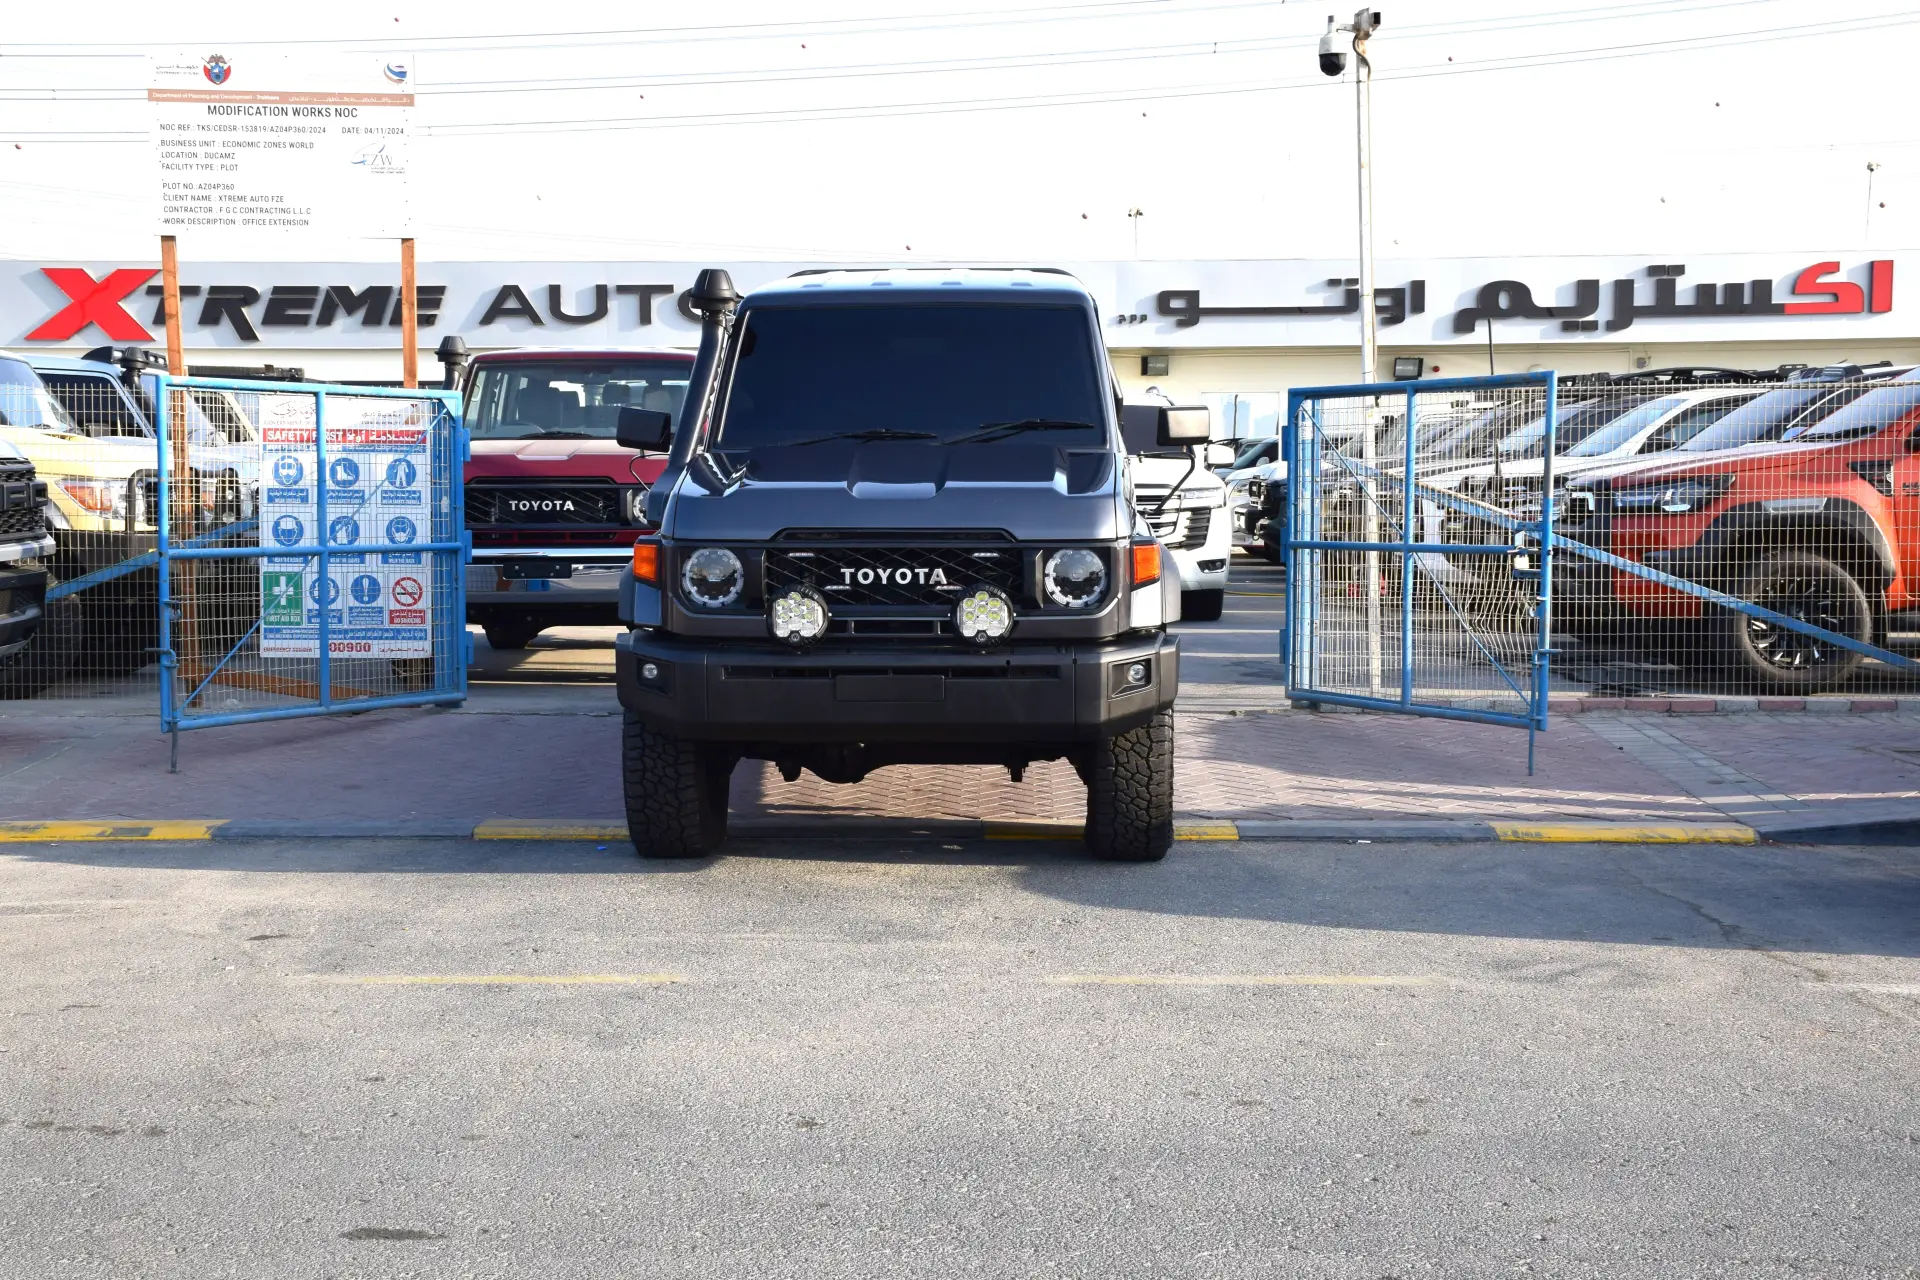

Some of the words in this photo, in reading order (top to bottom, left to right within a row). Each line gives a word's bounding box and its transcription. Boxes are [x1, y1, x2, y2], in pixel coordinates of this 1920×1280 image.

[188, 93, 210, 101] Planning
[207, 104, 289, 116] MODIFICATION
[292, 105, 331, 117] WORKS
[334, 106, 359, 118] NOC
[159, 123, 176, 131] NOC
[341, 126, 362, 134] DATE:
[364, 127, 405, 135] 04/11/2024
[160, 139, 197, 147] BUSINESS
[199, 140, 216, 148] UNIT
[222, 140, 261, 149] ECONOMIC
[263, 141, 287, 149] ZONES
[288, 142, 315, 150] WORLD
[161, 151, 198, 159] LOCATION
[204, 152, 236, 160] DUCAMZ
[161, 162, 194, 171] FACILITY
[195, 163, 214, 171] TYPE
[220, 164, 239, 172] PLOT
[162, 182, 181, 190] PLOT
[163, 193, 189, 202] CLIENT
[190, 194, 212, 202] NAME
[218, 195, 248, 203] XTREME
[249, 195, 270, 203] AUTO
[163, 205, 213, 214] CONTRACTOR
[239, 207, 291, 215] CONTRACTING
[187, 217, 236, 226] DESCRIPTION
[241, 218, 267, 226] OFFICE
[268, 218, 309, 227] EXTENSION
[24, 266, 447, 342] XTREME
[267, 430, 310, 441] SAFETY
[311, 431, 343, 442] FRST
[508, 500, 575, 511] TOYOTA
[840, 568, 948, 585] TOYOTA
